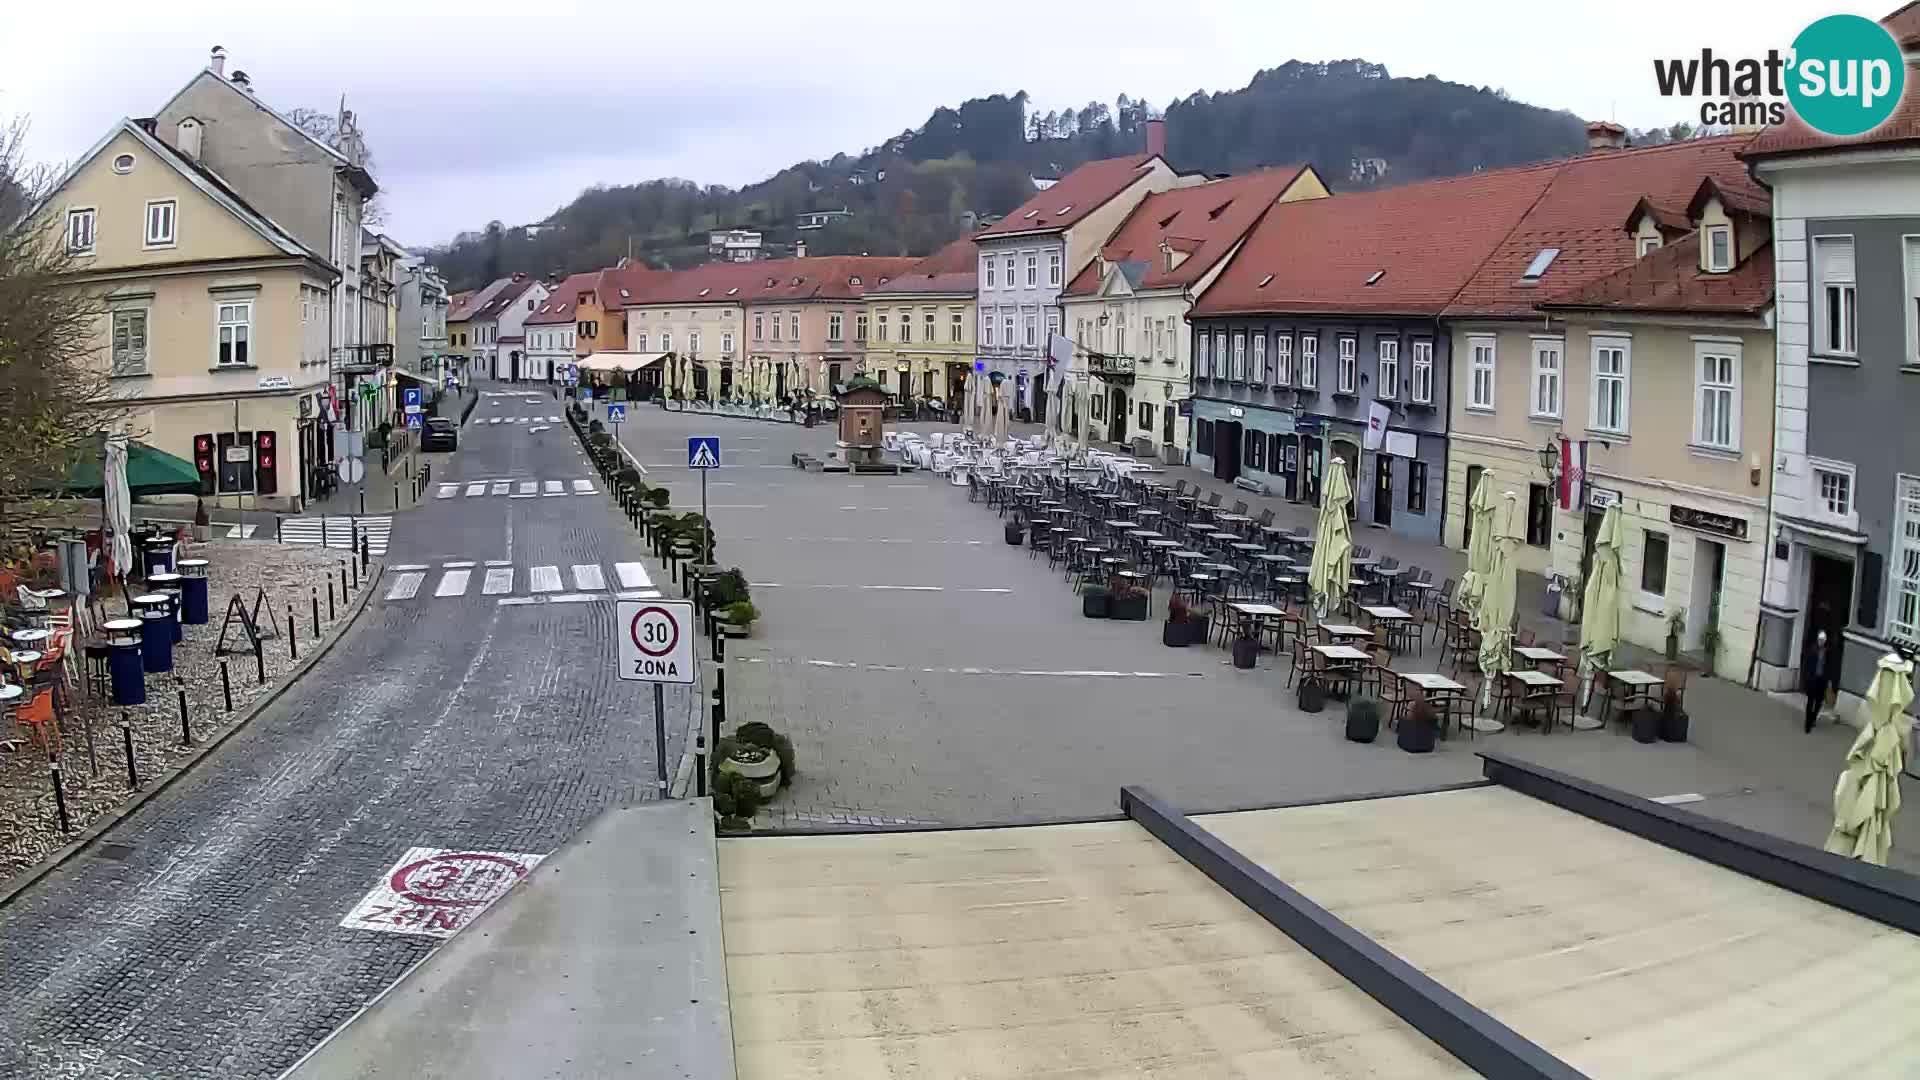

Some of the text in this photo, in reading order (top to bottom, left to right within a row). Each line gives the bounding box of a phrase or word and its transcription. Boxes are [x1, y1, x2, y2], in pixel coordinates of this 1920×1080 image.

[644, 622, 668, 644] 30
[634, 659, 679, 677] ZONA
[358, 904, 466, 930] ZON
